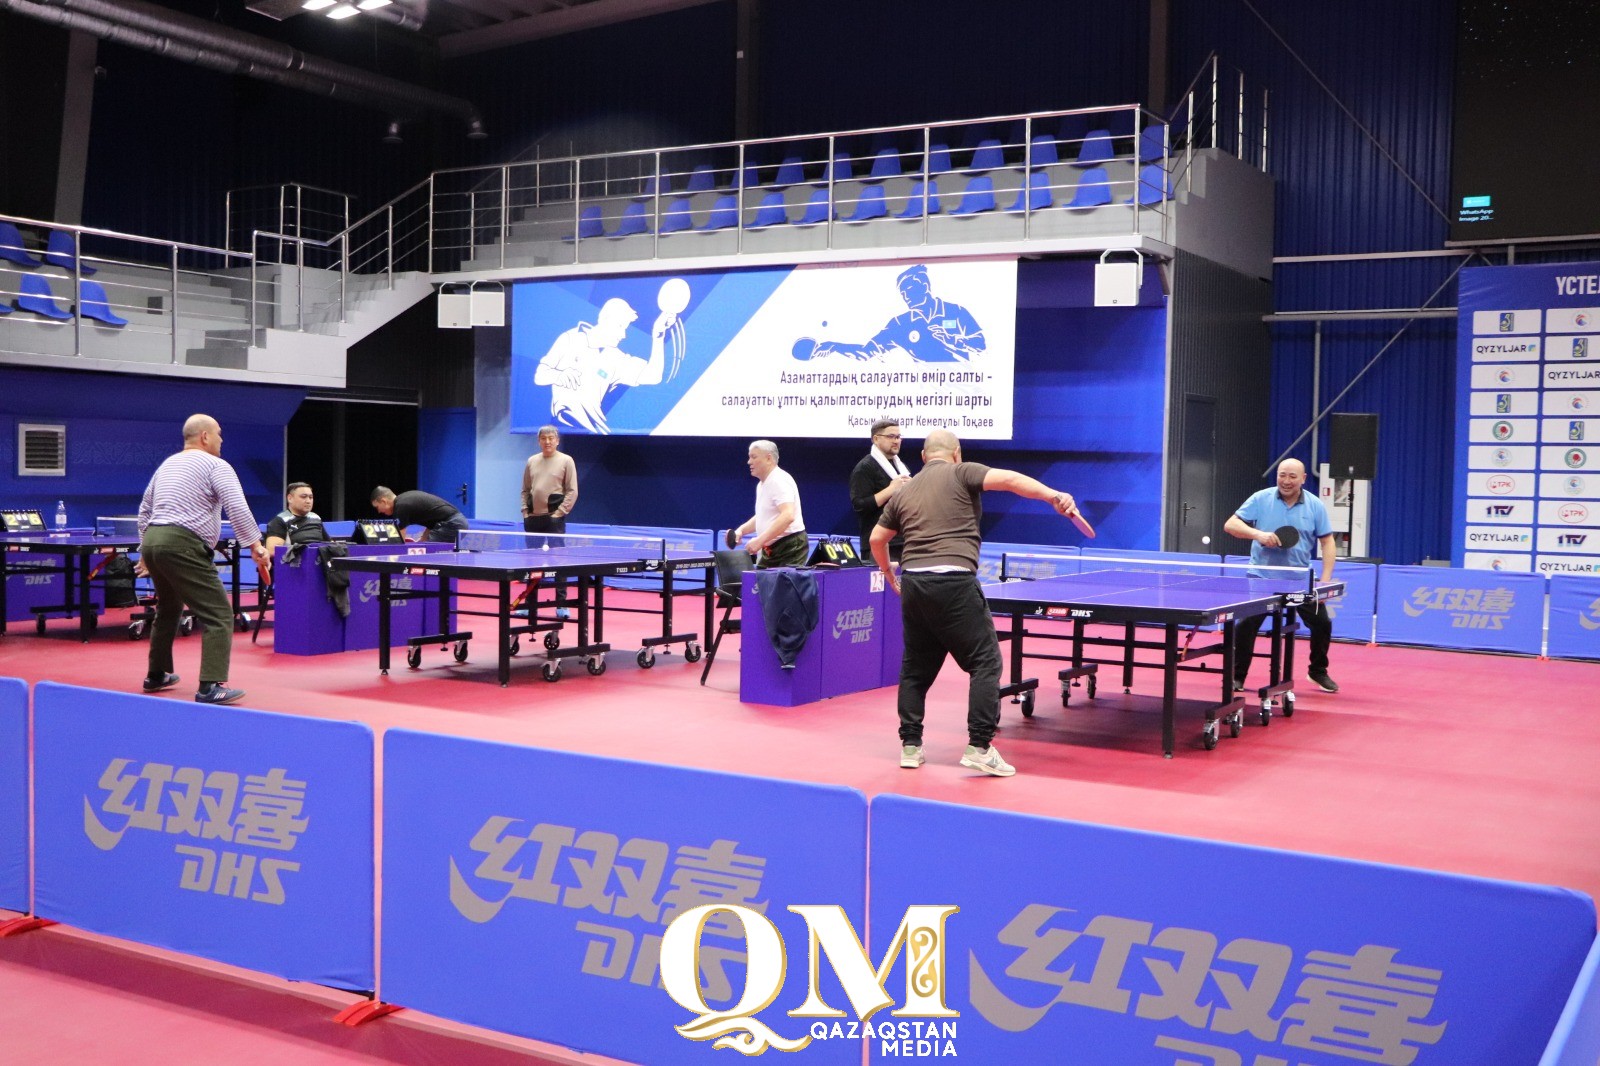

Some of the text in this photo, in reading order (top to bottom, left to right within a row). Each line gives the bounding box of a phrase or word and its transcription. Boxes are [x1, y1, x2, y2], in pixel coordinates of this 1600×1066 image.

[1476, 344, 1527, 353] QYZYLJAR
[780, 371, 858, 386] Азаматтардың
[860, 372, 919, 386] салауатты
[921, 369, 946, 386] өмір
[949, 371, 984, 383] салты
[1548, 371, 1600, 380] QYZYLJAR
[721, 392, 992, 409] салауатты ұлтты қалыптастырудың негізгі шарты
[916, 416, 960, 428] Кемелұлы
[962, 415, 994, 428] Тоқаев
[363, 524, 378, 538] 2
[386, 524, 400, 538] 2
[1469, 533, 1520, 542] QYZYLJAR
[825, 544, 838, 560] 0
[842, 543, 854, 559] 0
[1540, 562, 1592, 572] QYZYLJAR
[1403, 586, 1516, 618] 红双喜
[1071, 609, 1093, 618] DHS
[1451, 612, 1511, 630] DHS
[832, 605, 875, 640] 红双喜
[850, 628, 873, 644] DHS
[84, 757, 310, 852] 红双喜
[175, 844, 301, 906] DHS
[449, 815, 770, 939] 红双喜
[969, 902, 1449, 1066] 红双喜
